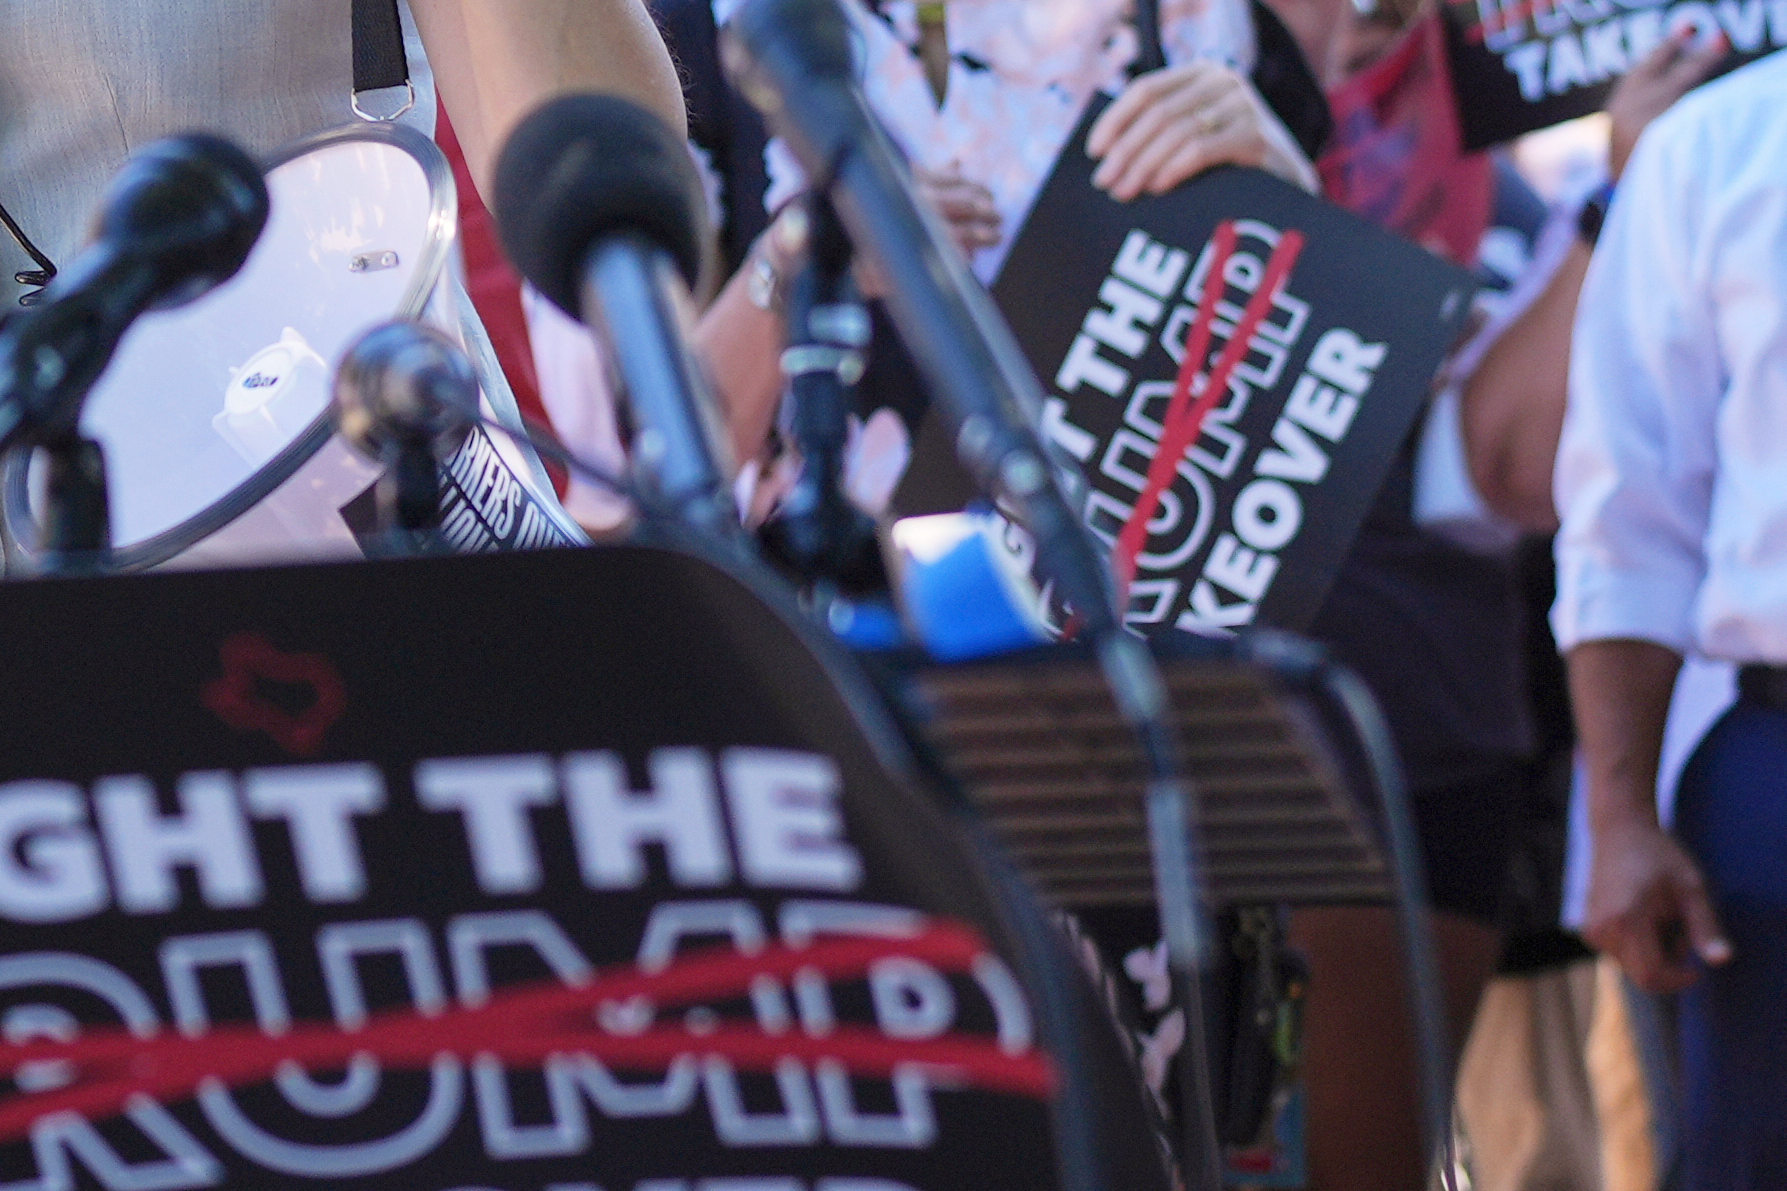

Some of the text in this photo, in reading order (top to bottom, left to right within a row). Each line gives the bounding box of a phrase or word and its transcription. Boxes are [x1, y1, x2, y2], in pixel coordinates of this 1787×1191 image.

[1054, 226, 1191, 398] THE
[442, 424, 522, 540] RKERS
[416, 745, 863, 895] THE
